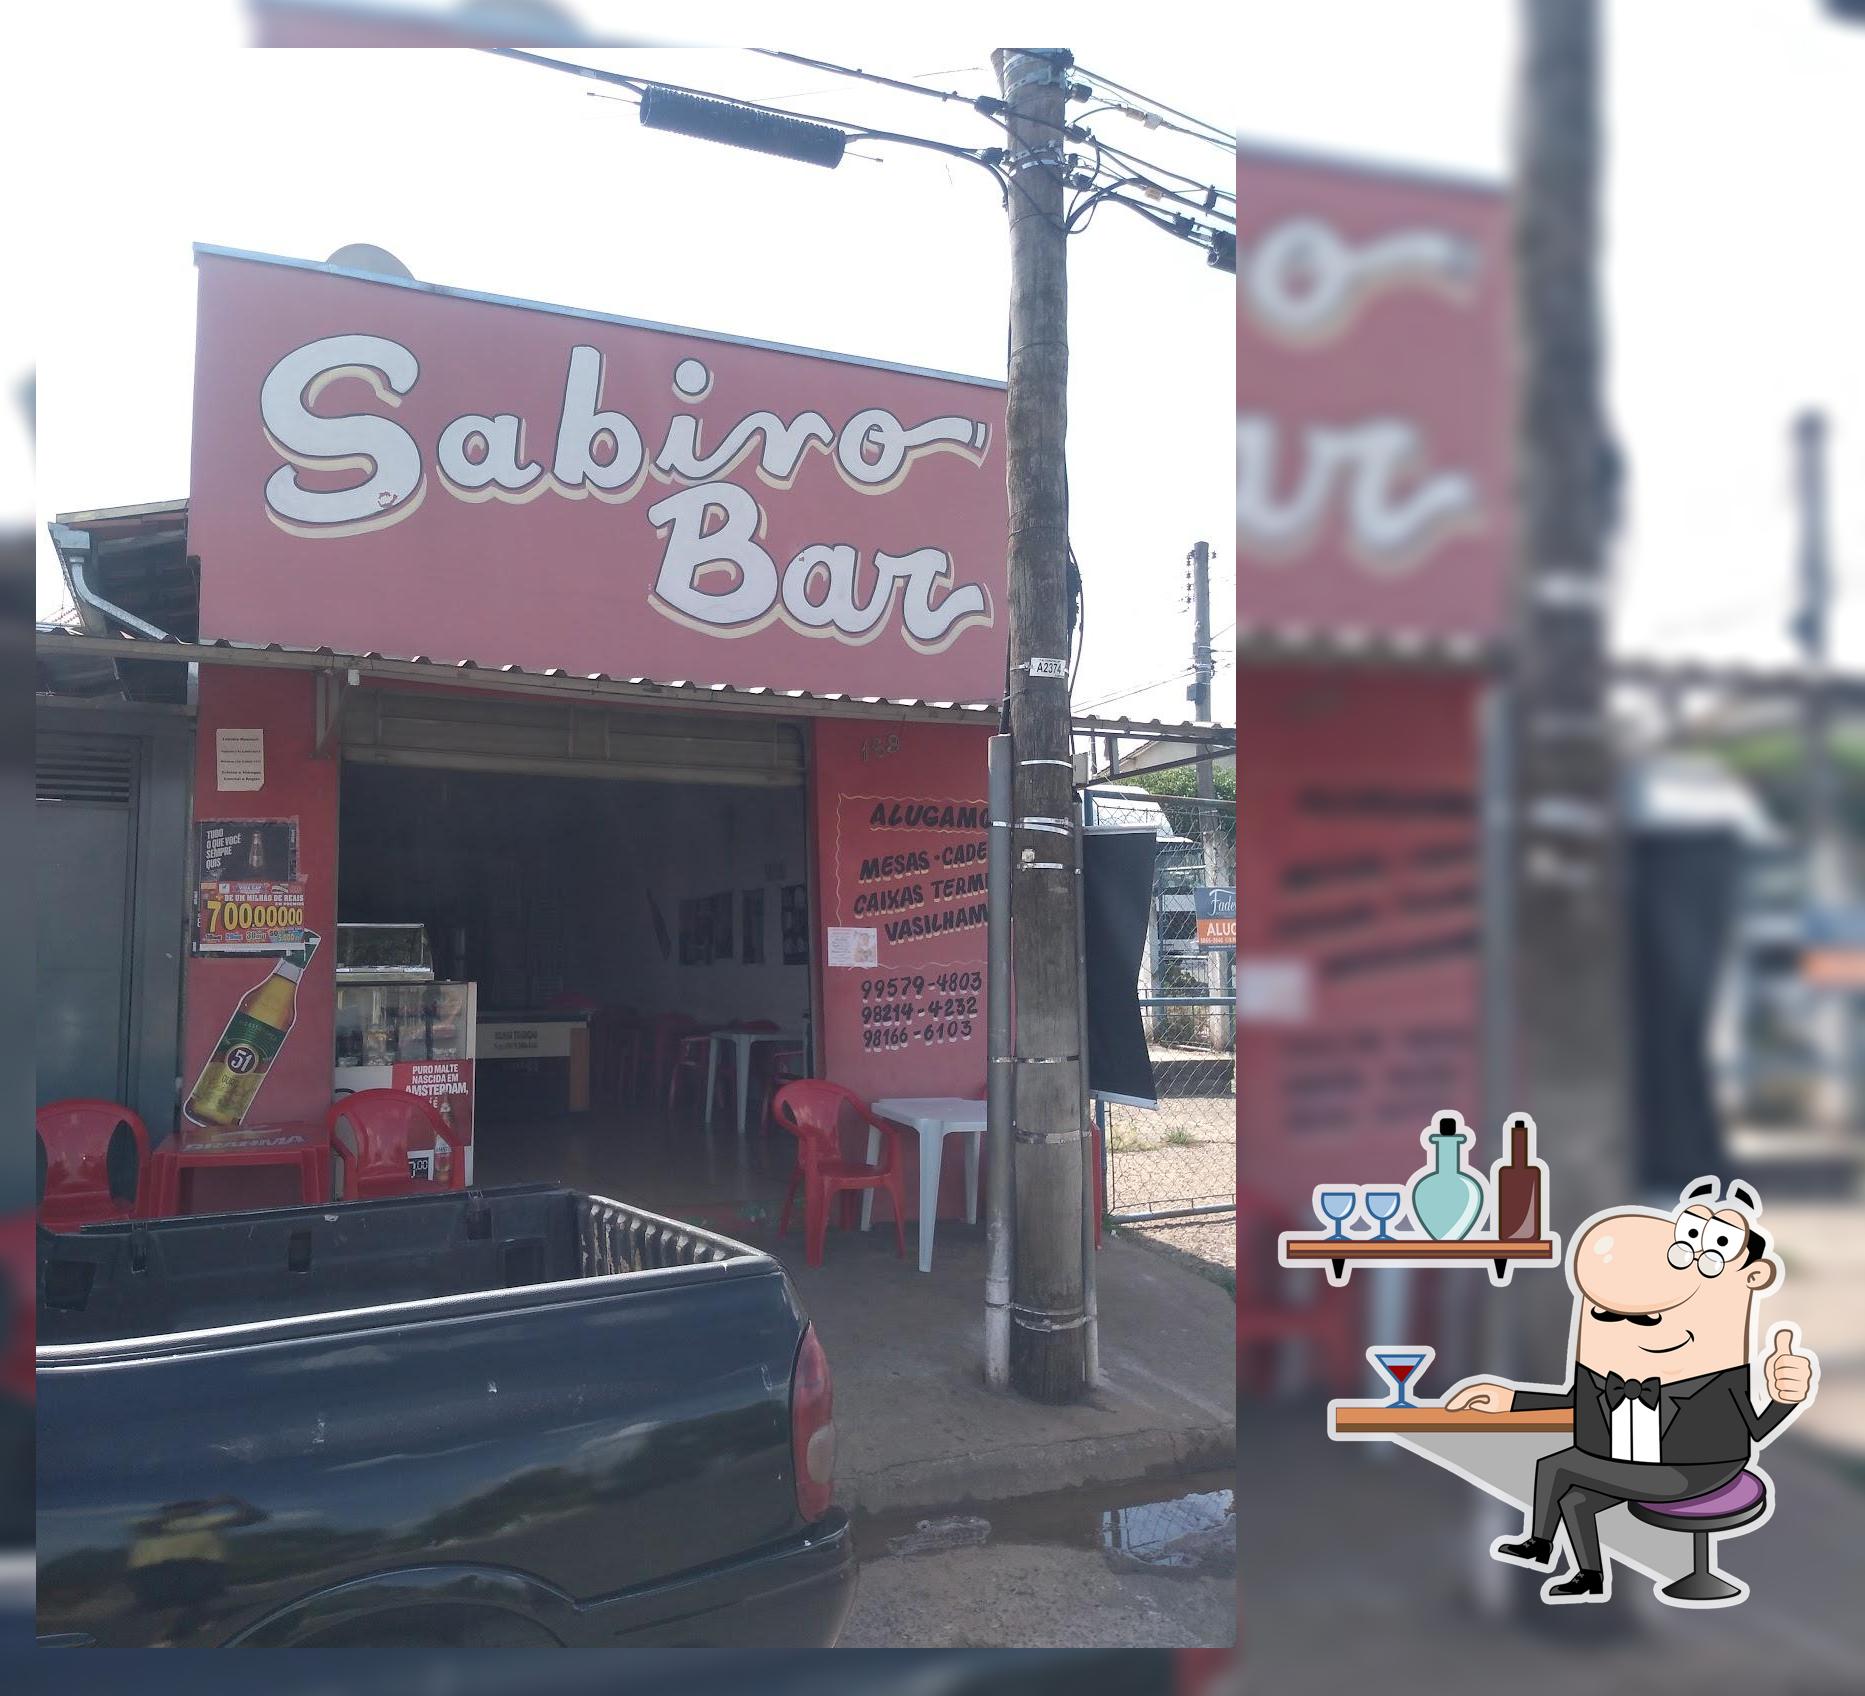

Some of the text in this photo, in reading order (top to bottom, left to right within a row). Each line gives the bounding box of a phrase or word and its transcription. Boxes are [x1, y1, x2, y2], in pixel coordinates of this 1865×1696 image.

[648, 481, 994, 655] Bar
[1036, 662, 1062, 674] A2374
[206, 845, 233, 860] SEMPRE
[206, 857, 221, 870] QUIS
[859, 850, 930, 882] MESAS
[224, 894, 234, 902] DE
[284, 894, 304, 902] REAIS
[853, 884, 924, 917] CAIXAS
[862, 971, 982, 1001] 99579-4803
[862, 997, 978, 1026] 98214-4232
[863, 1020, 973, 1051] 98166-6103
[231, 1049, 253, 1072] 51
[412, 1063, 459, 1075] PURO MALTE
[412, 1073, 459, 1085] NASCIDA EM
